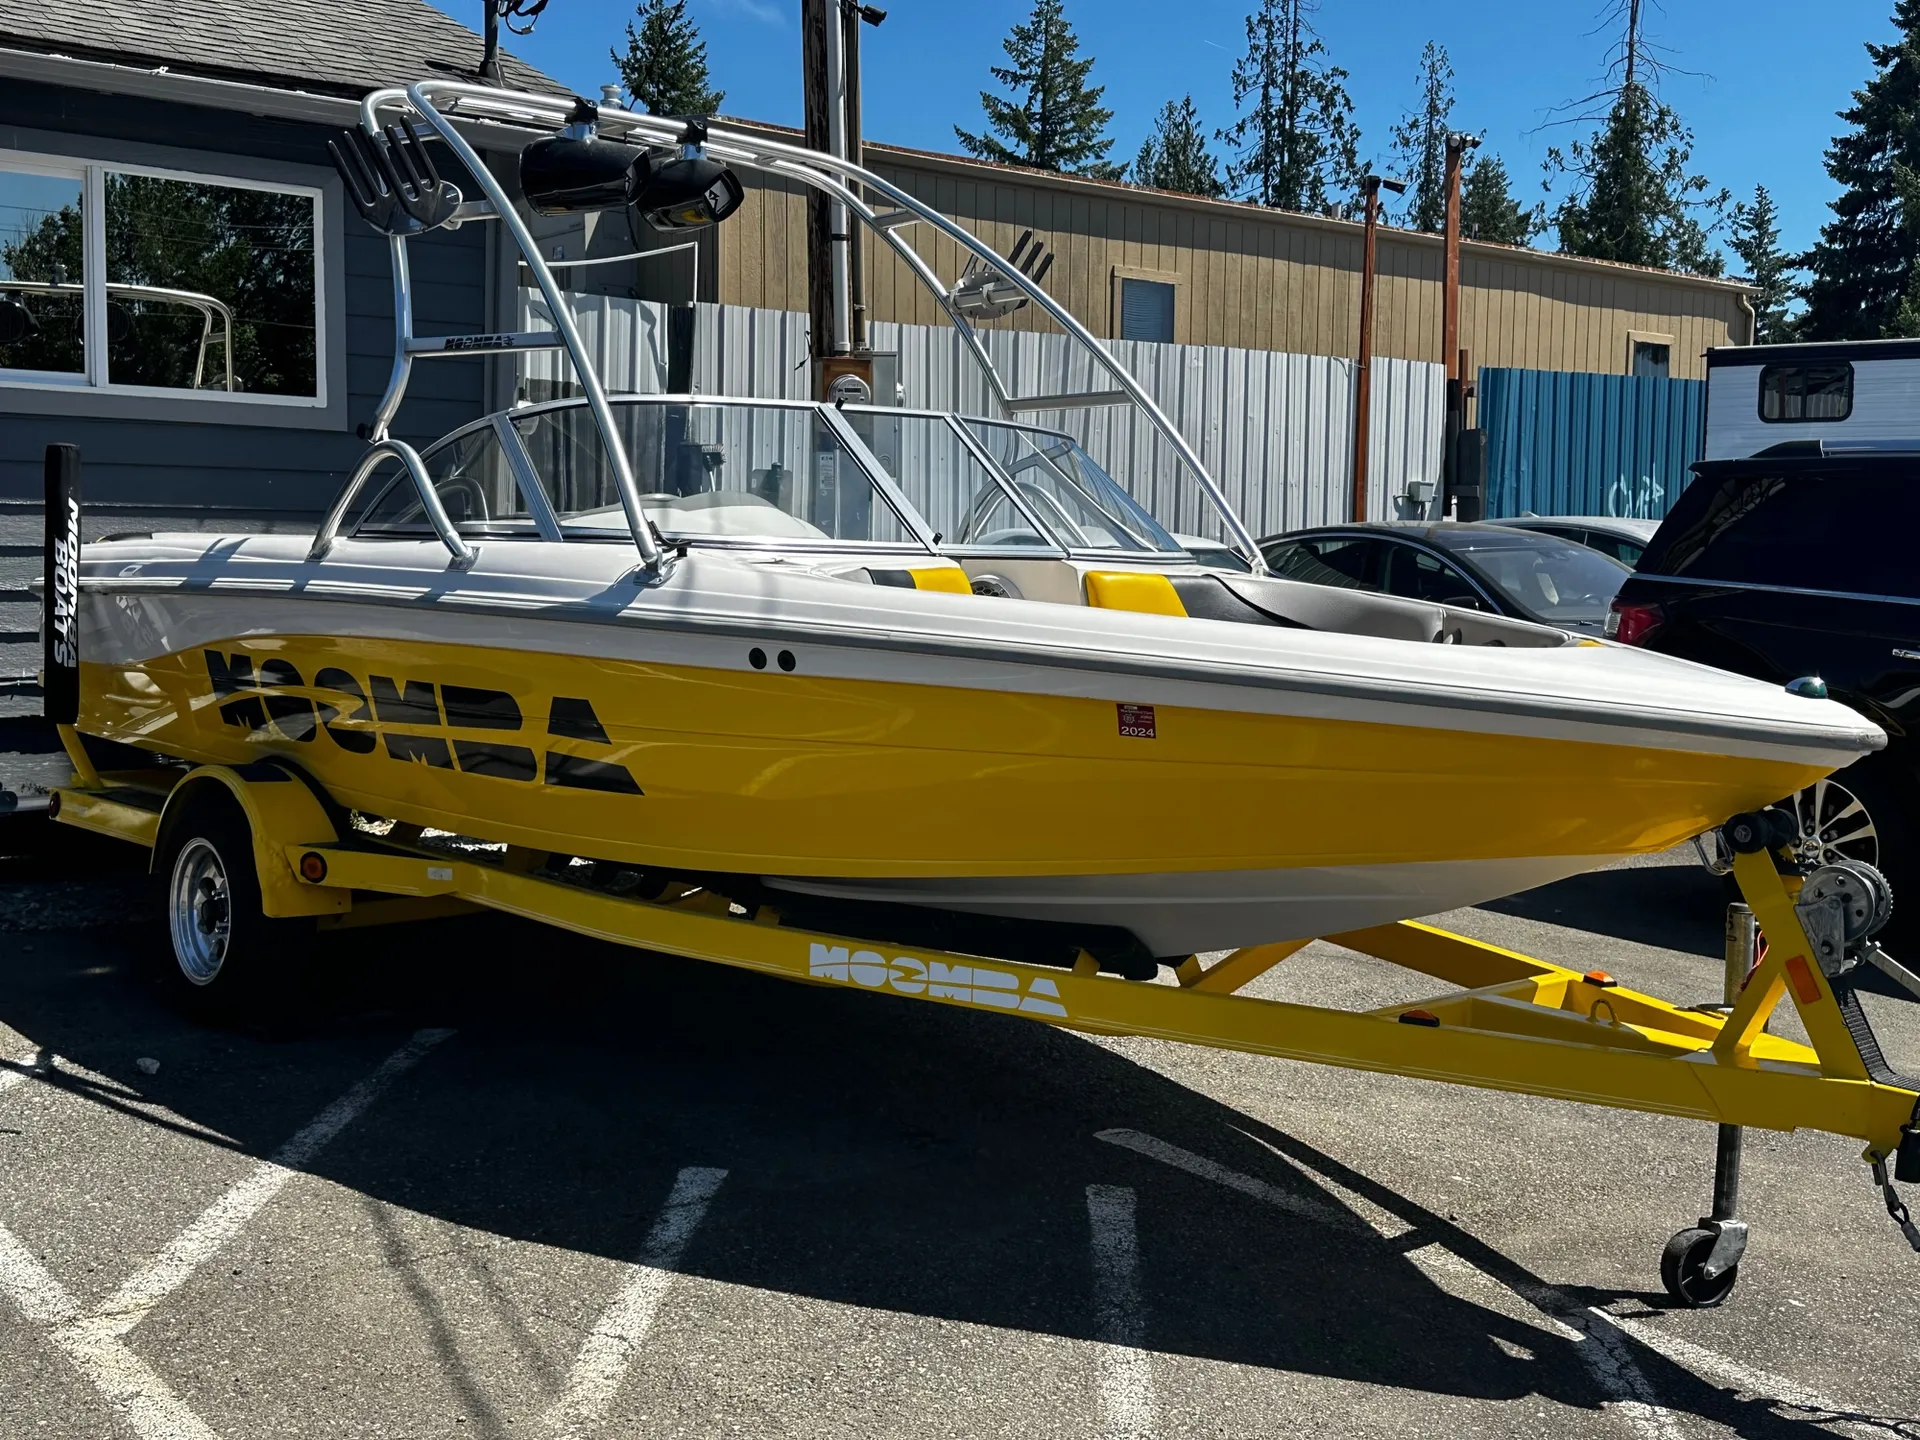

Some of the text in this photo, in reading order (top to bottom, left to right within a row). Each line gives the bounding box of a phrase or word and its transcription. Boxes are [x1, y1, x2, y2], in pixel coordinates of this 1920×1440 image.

[444, 335, 502, 350] MOOMBA
[54, 537, 68, 667] BOATS
[68, 497, 79, 667] MOOMBA
[204, 649, 645, 796] MOOMBA
[1121, 726, 1154, 737] 2024
[809, 942, 1068, 1017] MOOMBA
